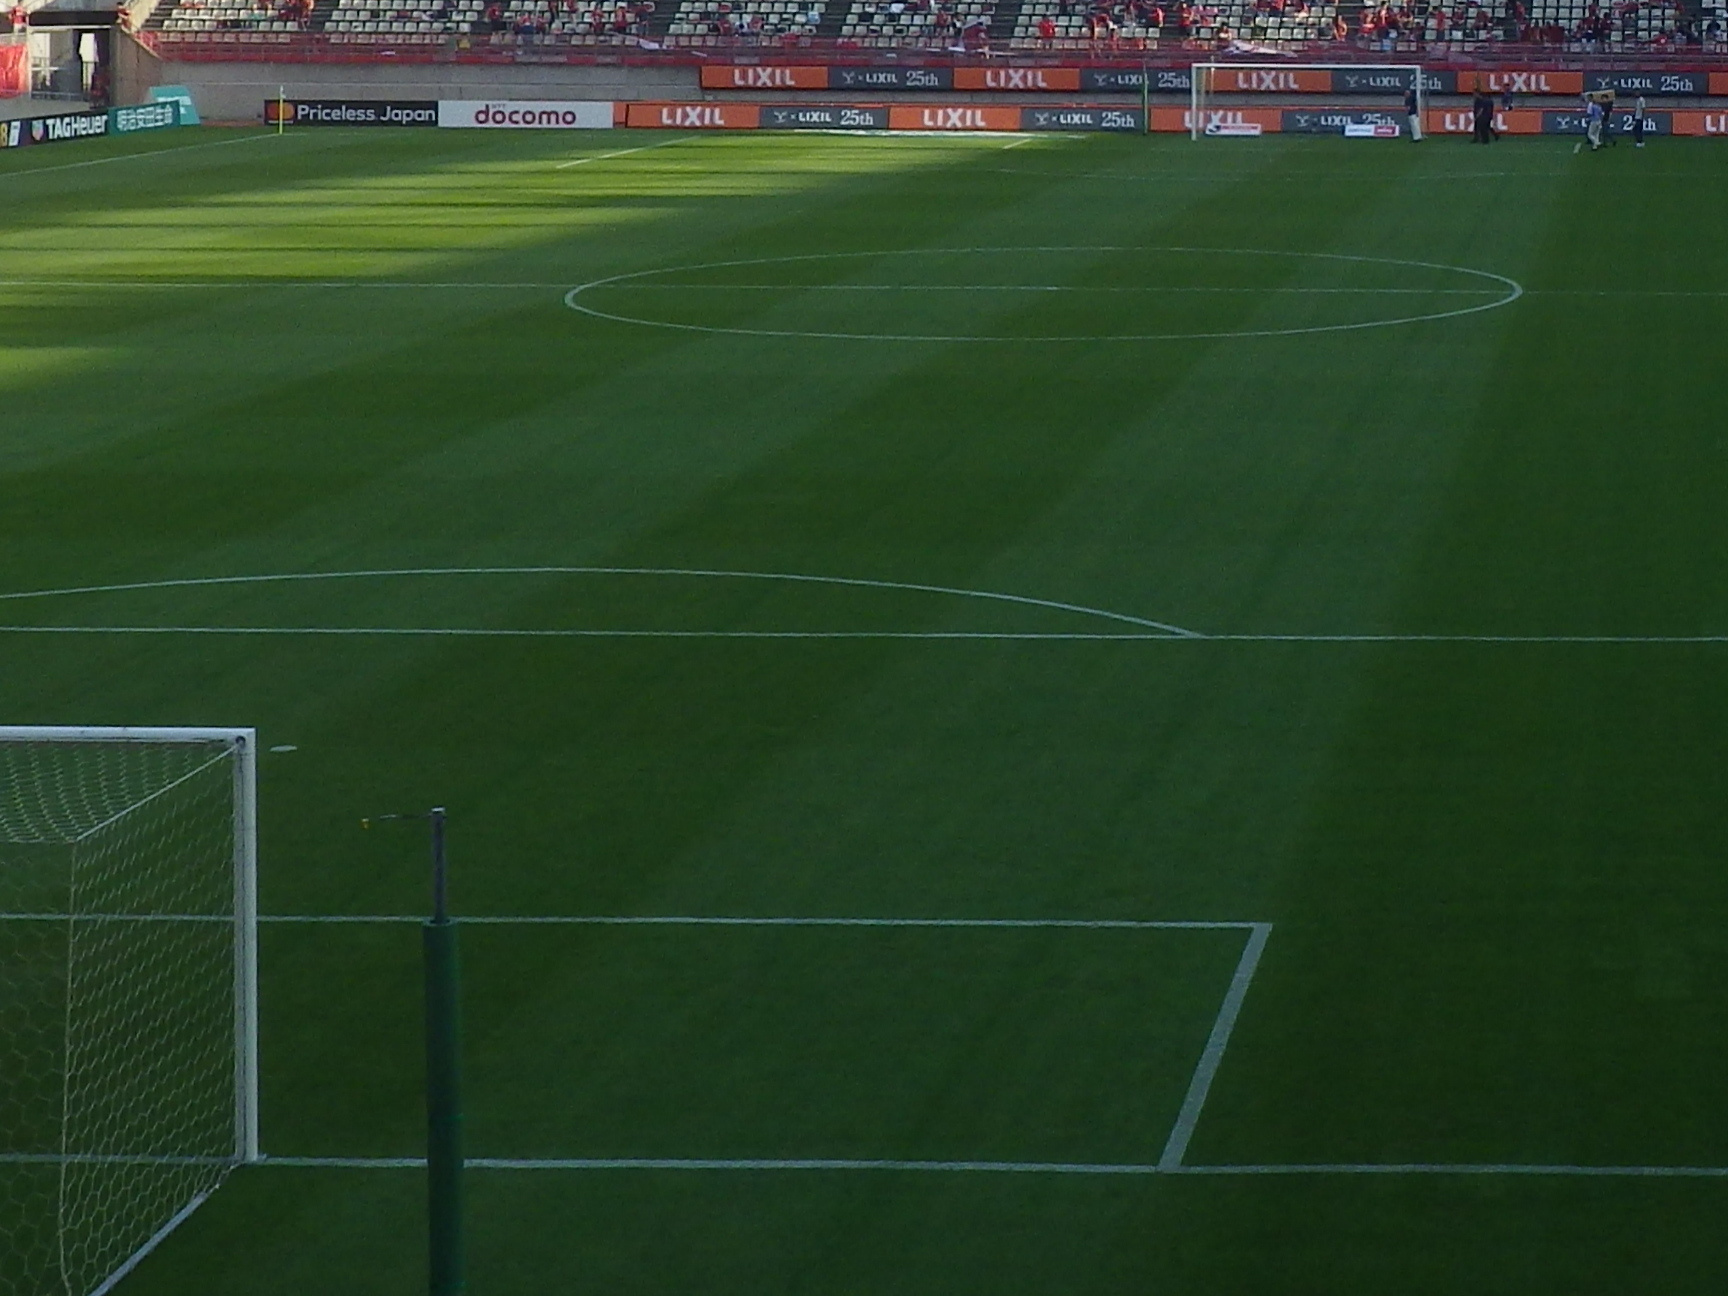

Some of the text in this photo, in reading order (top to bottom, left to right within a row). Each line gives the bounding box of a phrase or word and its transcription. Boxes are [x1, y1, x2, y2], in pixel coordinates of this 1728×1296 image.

[734, 67, 796, 87] LIXIL
[866, 71, 938, 86] LIXIL 25th
[985, 69, 1048, 88] LIXIL
[1158, 72, 1190, 88] 25th
[1237, 71, 1300, 90] LIXIL
[1370, 76, 1401, 86] LIXIL
[1489, 73, 1552, 91] LIXIL
[1620, 76, 1693, 92] LIXIL 25th
[297, 104, 436, 126] Priceless Japan
[474, 104, 577, 126] docomo
[662, 106, 725, 126] LIXIL
[799, 109, 874, 126] LIXIL 25th
[922, 108, 986, 128] LIXIL
[1060, 112, 1135, 128] LIXIL 25th
[1320, 114, 1395, 126] LIXIL 25th
[1623, 115, 1656, 132] 2th
